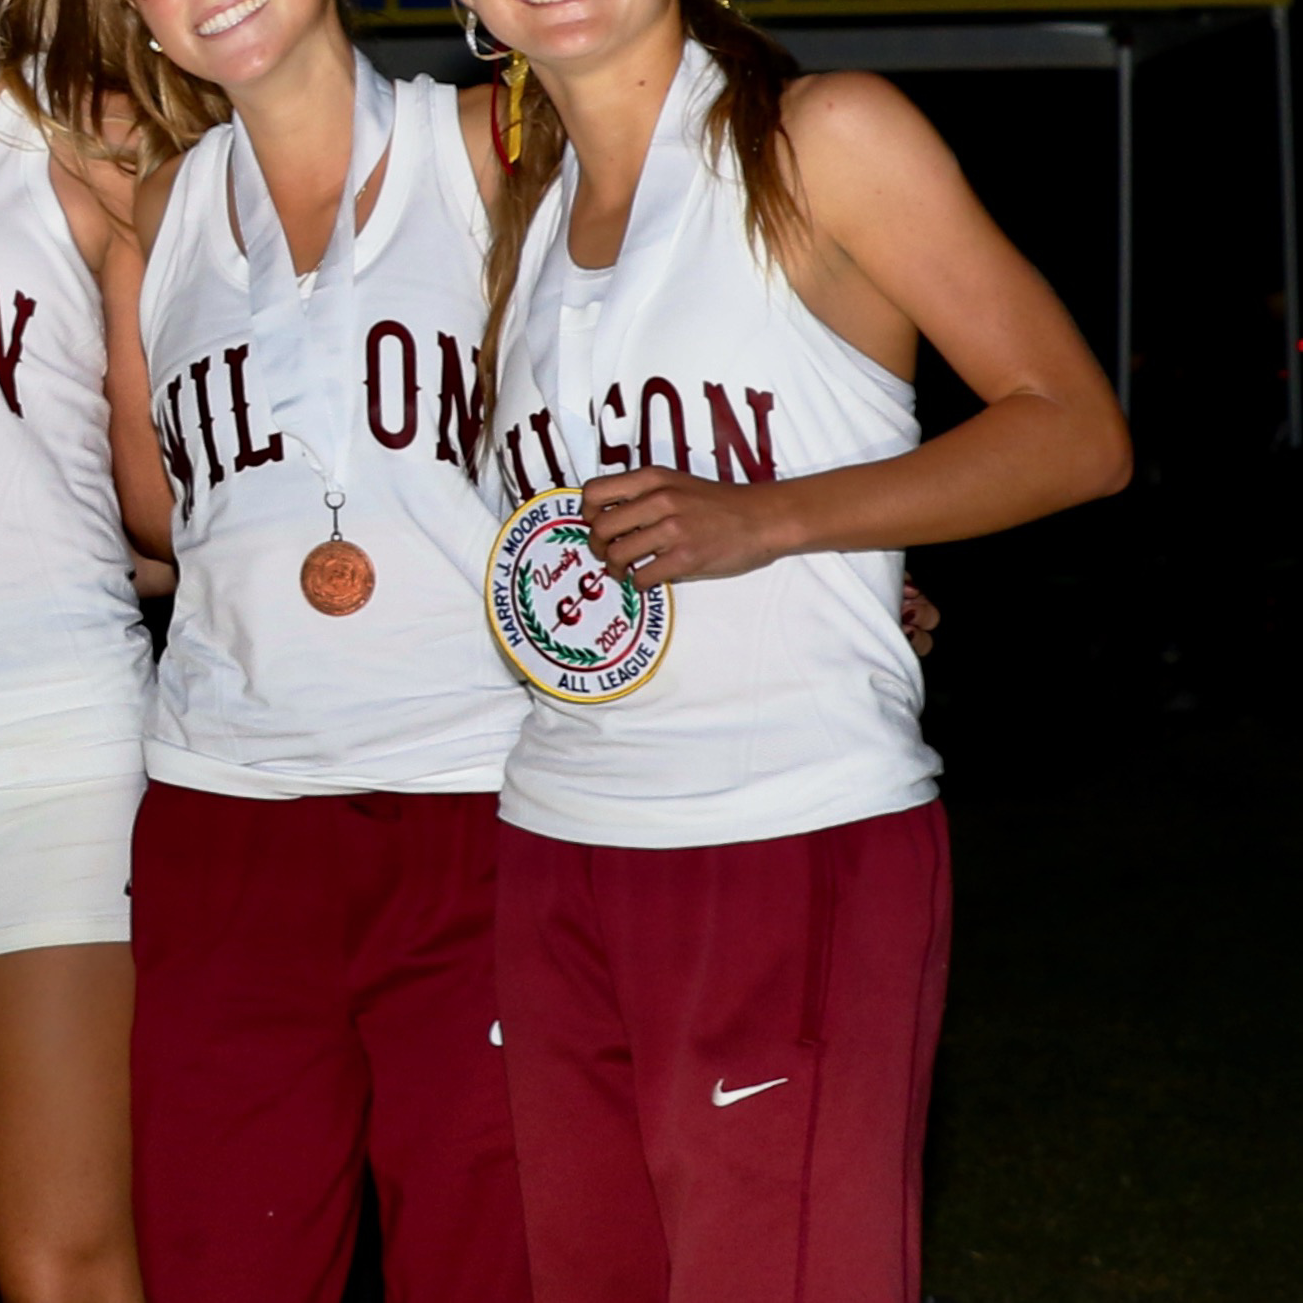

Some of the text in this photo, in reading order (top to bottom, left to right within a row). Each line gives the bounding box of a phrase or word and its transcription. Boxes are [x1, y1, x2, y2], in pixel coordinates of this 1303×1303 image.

[157, 319, 486, 529] WILON
[496, 376, 778, 510] ILSON
[503, 503, 551, 557] MOORE
[533, 547, 583, 591] Varsity
[494, 579, 524, 648] HARRY
[557, 584, 665, 693] ALL LEAGUE AWAR
[596, 615, 630, 654] 2025
